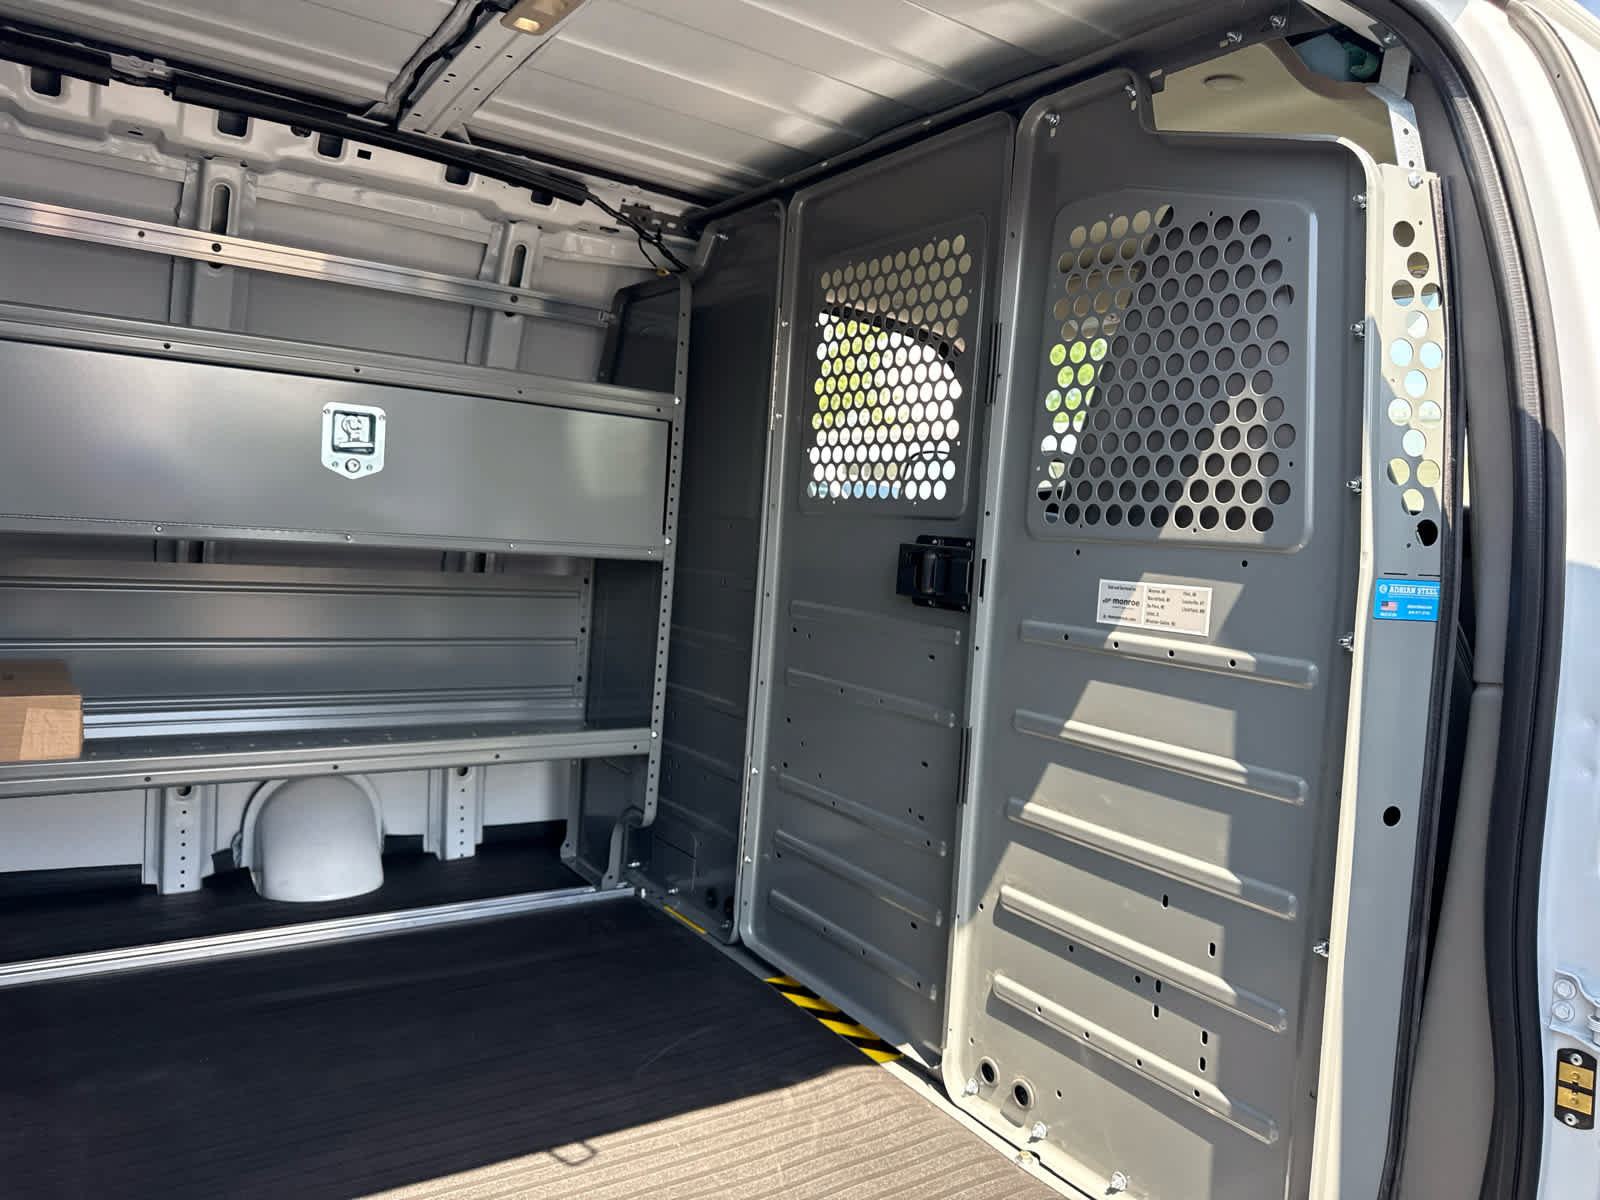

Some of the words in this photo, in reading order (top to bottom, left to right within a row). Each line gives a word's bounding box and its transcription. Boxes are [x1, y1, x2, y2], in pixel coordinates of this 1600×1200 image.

[1389, 586, 1416, 594] ADRIAN
[1417, 587, 1438, 595] STEEL
[1113, 598, 1140, 607] monroe
